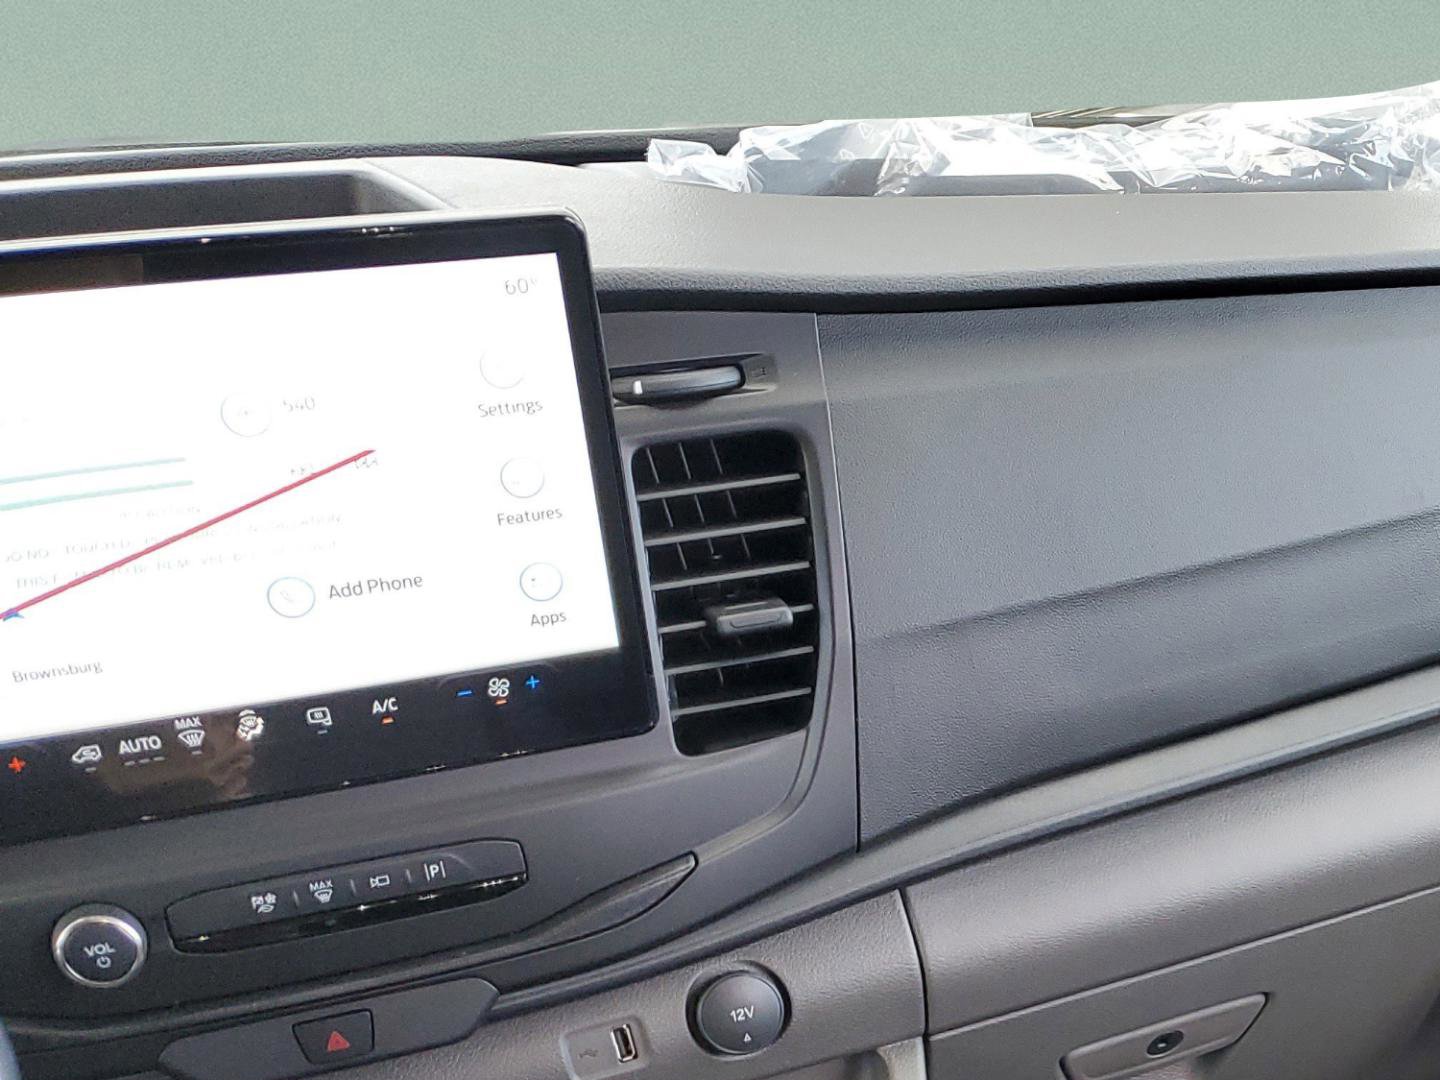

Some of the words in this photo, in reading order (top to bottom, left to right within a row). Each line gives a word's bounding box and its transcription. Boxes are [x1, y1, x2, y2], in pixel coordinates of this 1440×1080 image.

[477, 400, 544, 418] Settings
[496, 508, 564, 526] Features
[329, 580, 363, 600] Add
[366, 576, 423, 594] Phone
[530, 611, 568, 627] Apps
[11, 661, 104, 683] Brownsburg
[372, 697, 399, 716] A/C
[174, 716, 201, 730] MAX
[118, 735, 162, 756] AUTO
[309, 879, 334, 893] MAX
[83, 941, 117, 957] VOL
[730, 1005, 755, 1023] 12V
